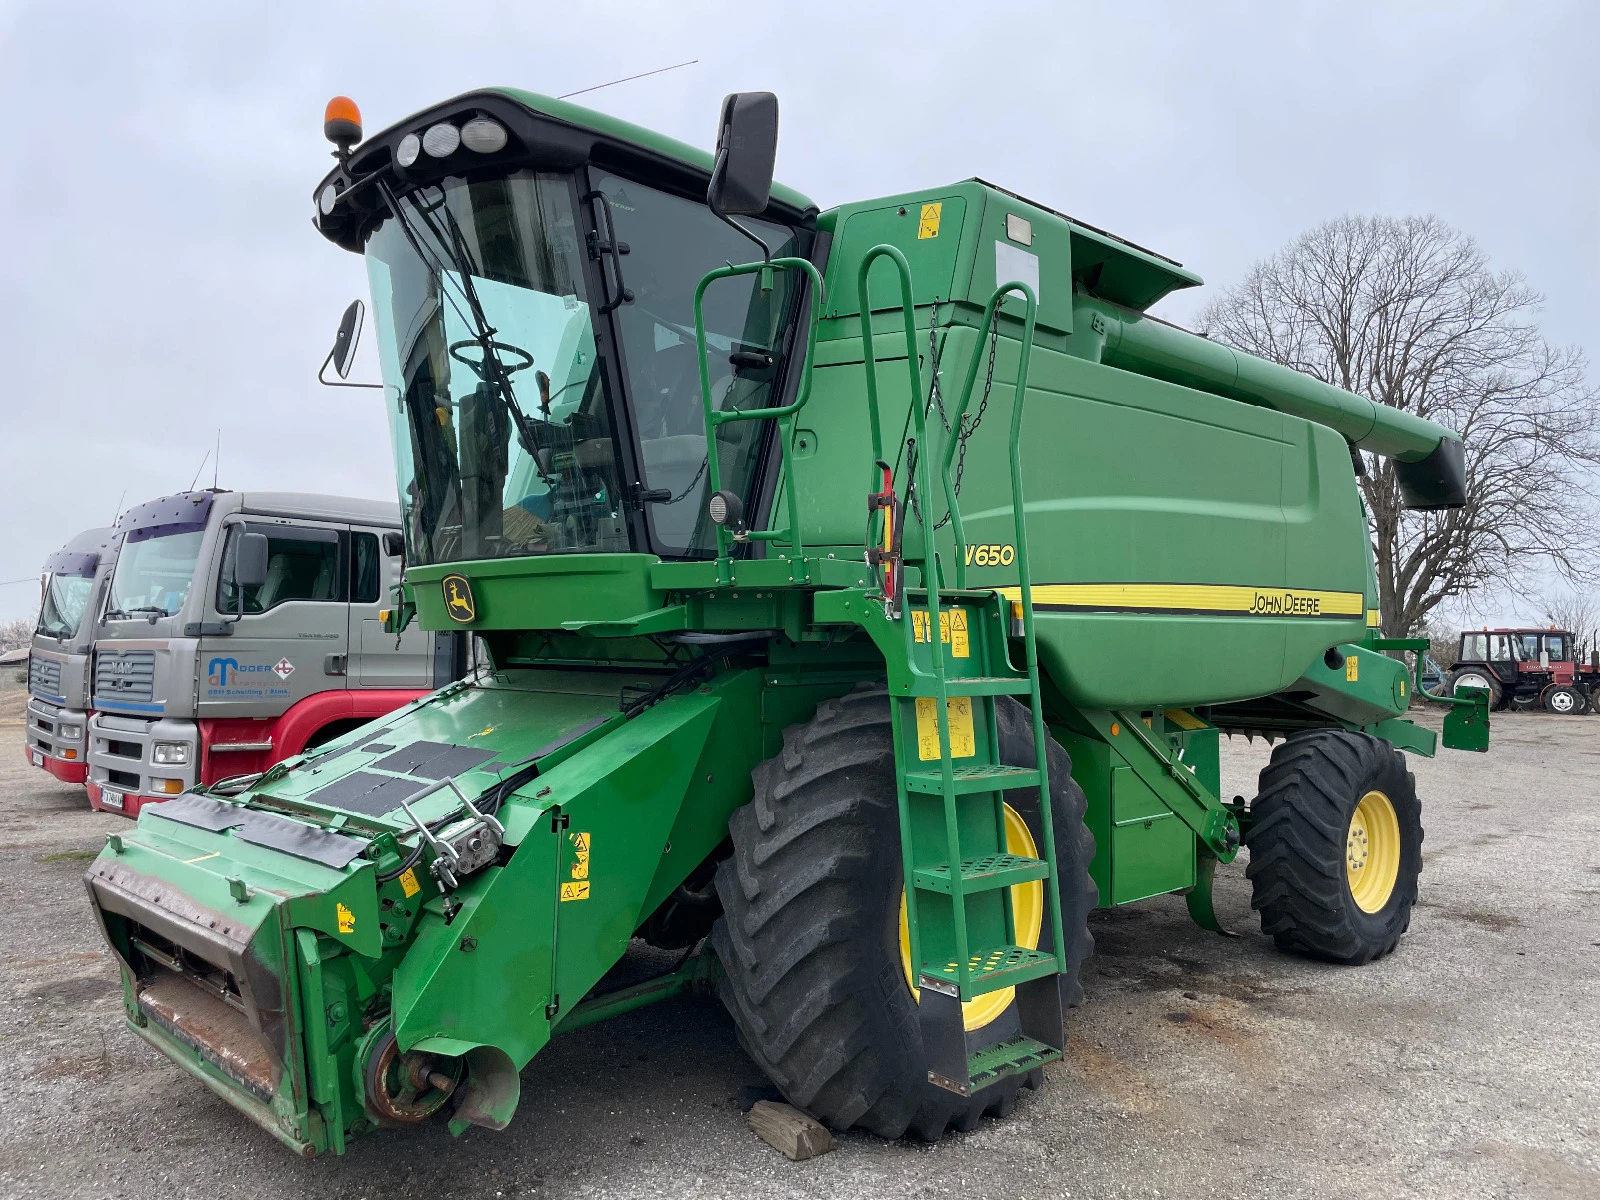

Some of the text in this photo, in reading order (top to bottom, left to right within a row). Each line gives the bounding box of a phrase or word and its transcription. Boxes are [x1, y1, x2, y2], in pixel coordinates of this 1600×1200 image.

[1249, 592, 1320, 613] JOHN DEERE
[112, 661, 133, 674] MAN
